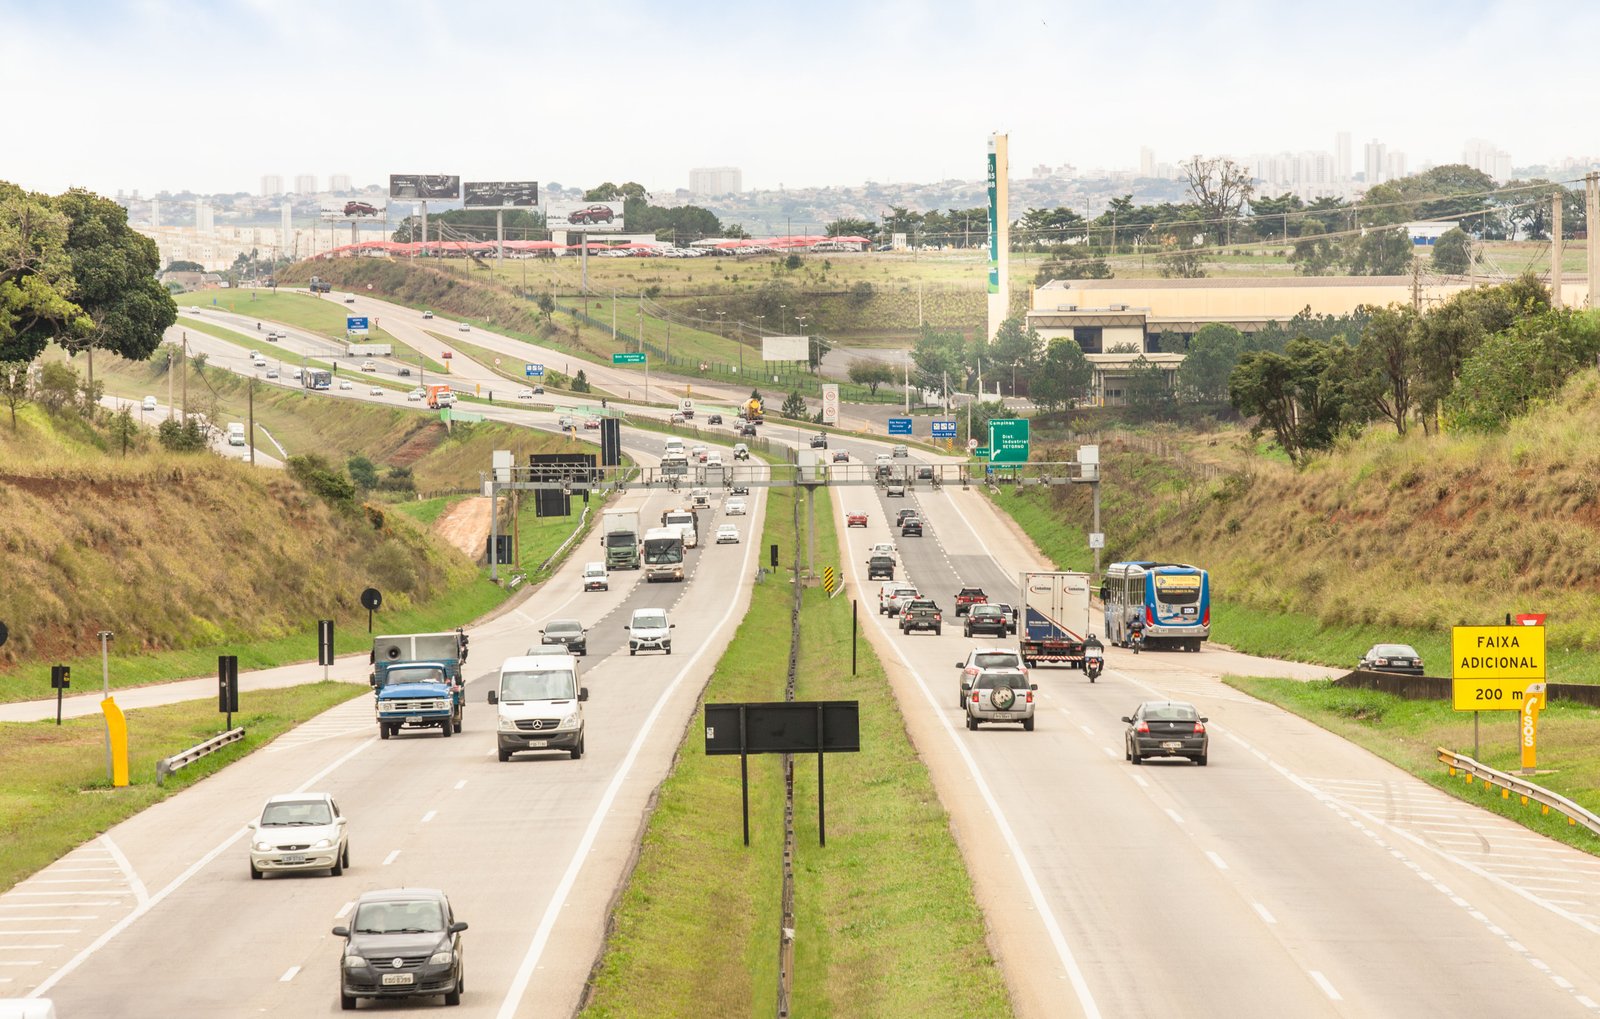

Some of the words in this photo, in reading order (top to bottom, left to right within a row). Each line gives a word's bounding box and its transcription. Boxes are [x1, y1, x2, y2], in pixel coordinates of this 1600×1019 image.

[1477, 636, 1520, 648] FAIXA
[1461, 657, 1538, 669] ADICIONAL
[1475, 688, 1503, 700] 200
[1512, 690, 1523, 700] m
[1523, 715, 1534, 747] SOS
